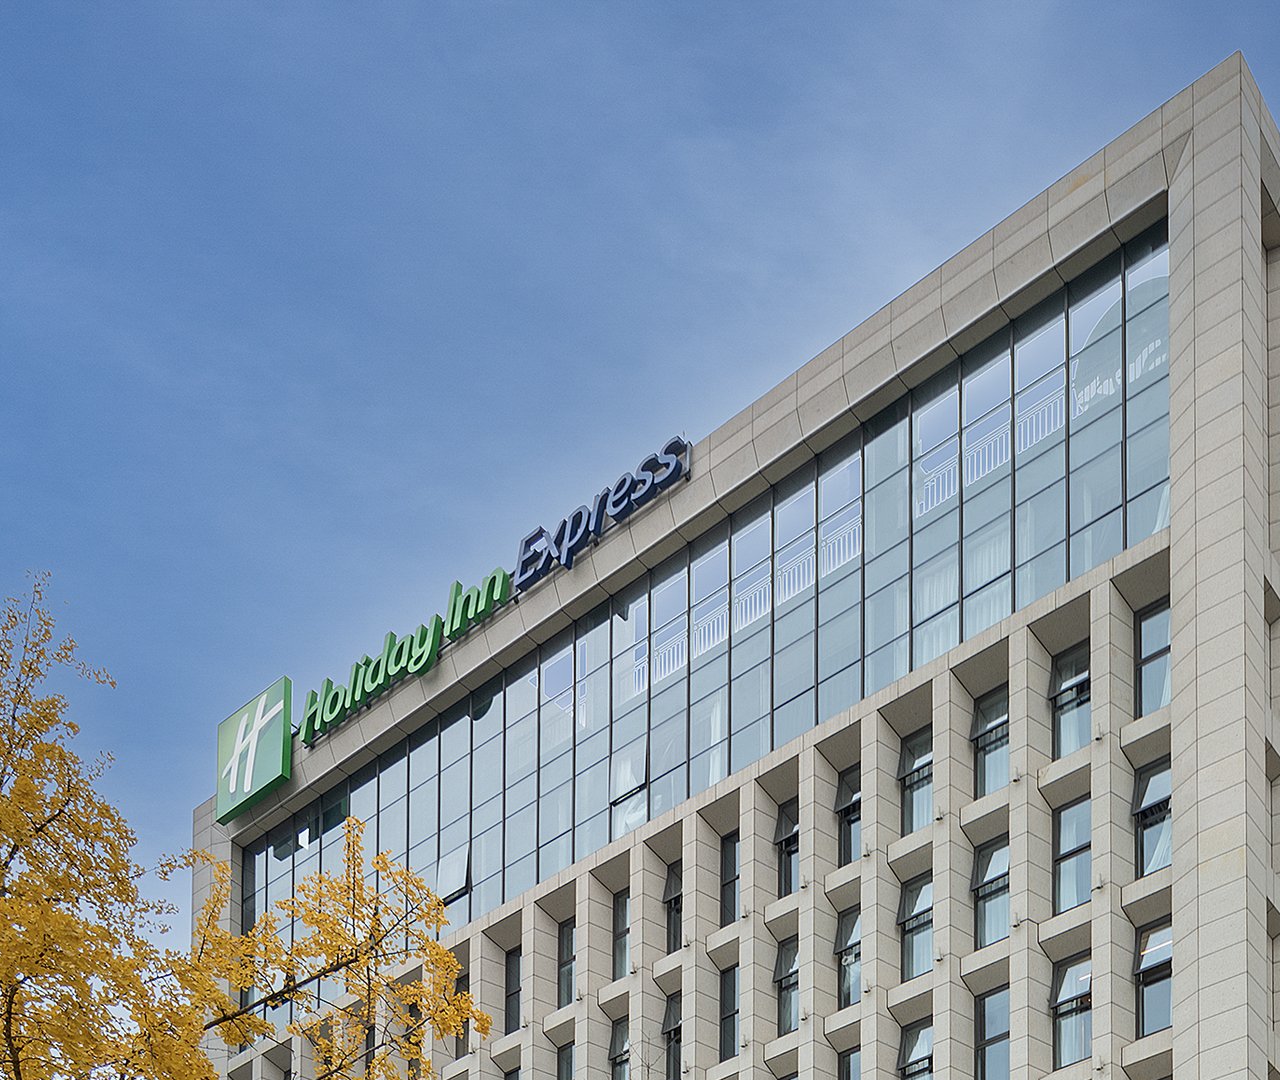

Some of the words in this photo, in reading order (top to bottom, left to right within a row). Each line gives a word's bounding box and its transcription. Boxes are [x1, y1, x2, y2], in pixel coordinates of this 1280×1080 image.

[299, 613, 443, 746] Holiday
[443, 566, 510, 642] Inn
[514, 435, 683, 592] Express
